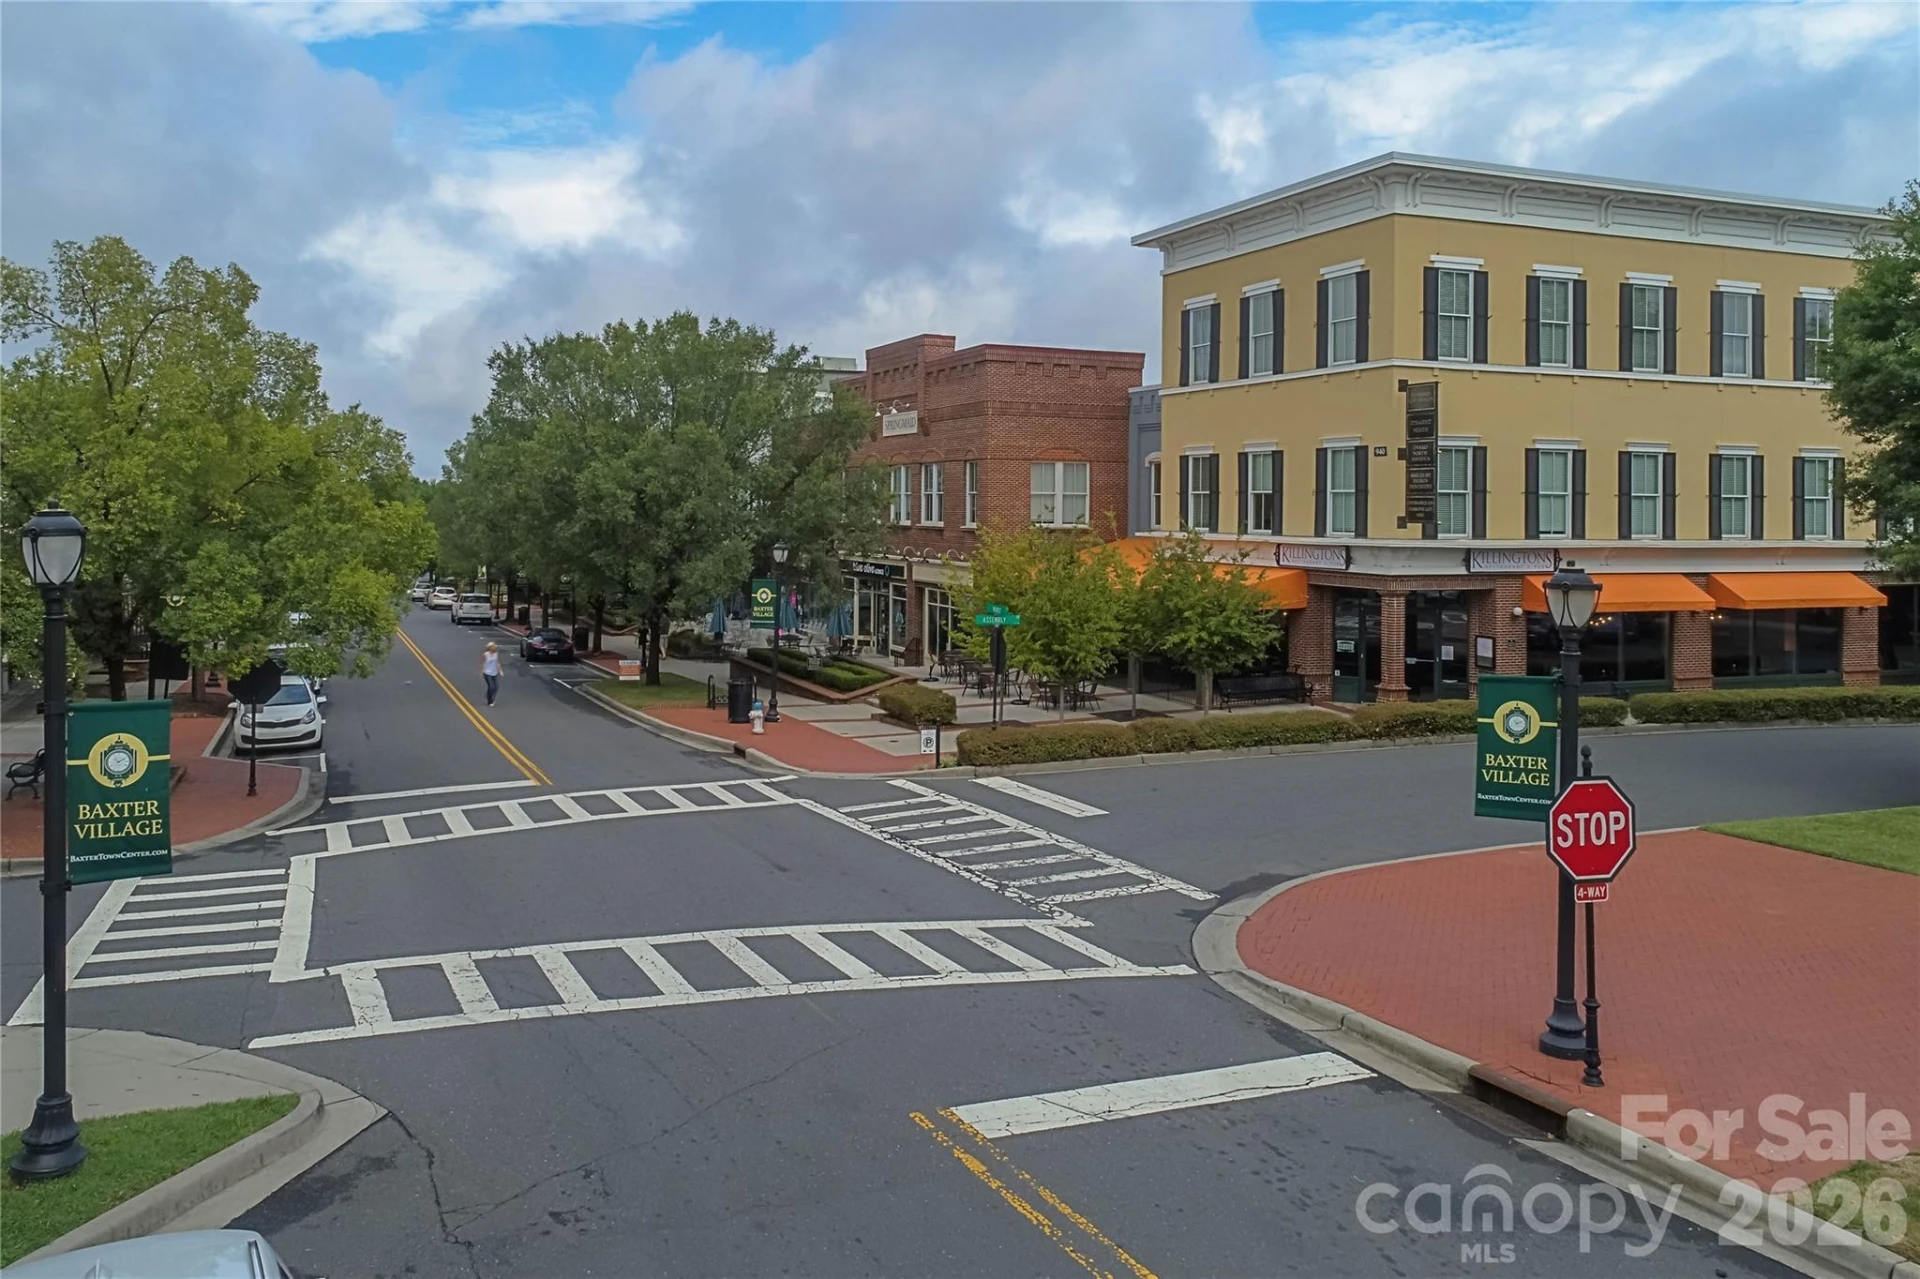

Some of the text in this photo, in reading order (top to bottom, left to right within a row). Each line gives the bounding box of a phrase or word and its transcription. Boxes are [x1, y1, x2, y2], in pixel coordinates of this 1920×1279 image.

[1282, 545, 1345, 566] KILLINGTONS
[1472, 550, 1553, 569] KILLINGTONS
[1485, 753, 1548, 770] BAXTER
[1482, 768, 1550, 786] VILLAGE
[78, 800, 160, 820] BAXTER
[73, 819, 163, 840] VILLAGE
[1556, 811, 1626, 848] STOP
[1577, 886, 1606, 898] 4-WAY
